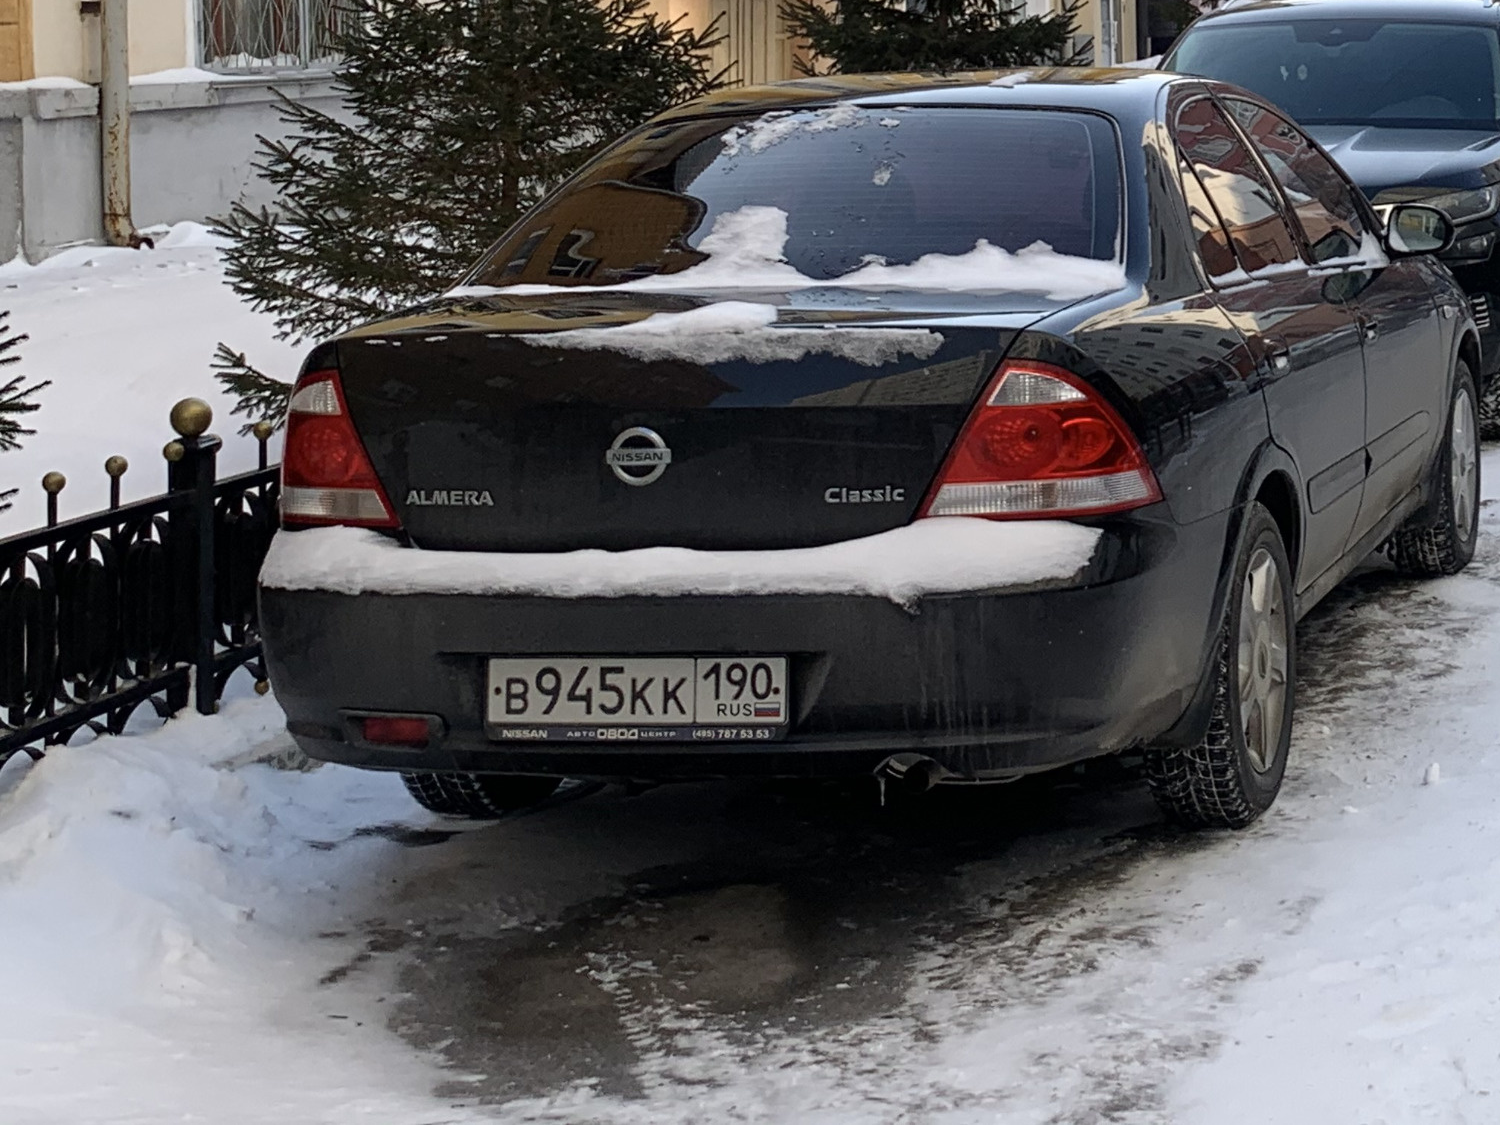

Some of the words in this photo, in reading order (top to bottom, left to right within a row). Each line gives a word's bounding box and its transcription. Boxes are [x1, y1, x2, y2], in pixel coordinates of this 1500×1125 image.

[611, 451, 665, 463] NISSAN
[405, 489, 495, 506] ALMERA
[824, 484, 906, 504] Classic
[504, 665, 688, 716] В945КК
[702, 662, 773, 701] 190
[716, 703, 753, 717] RUS
[502, 729, 548, 739] NISSAN
[718, 729, 737, 739] 787
[740, 729, 754, 739] 53
[756, 729, 770, 739] 53
